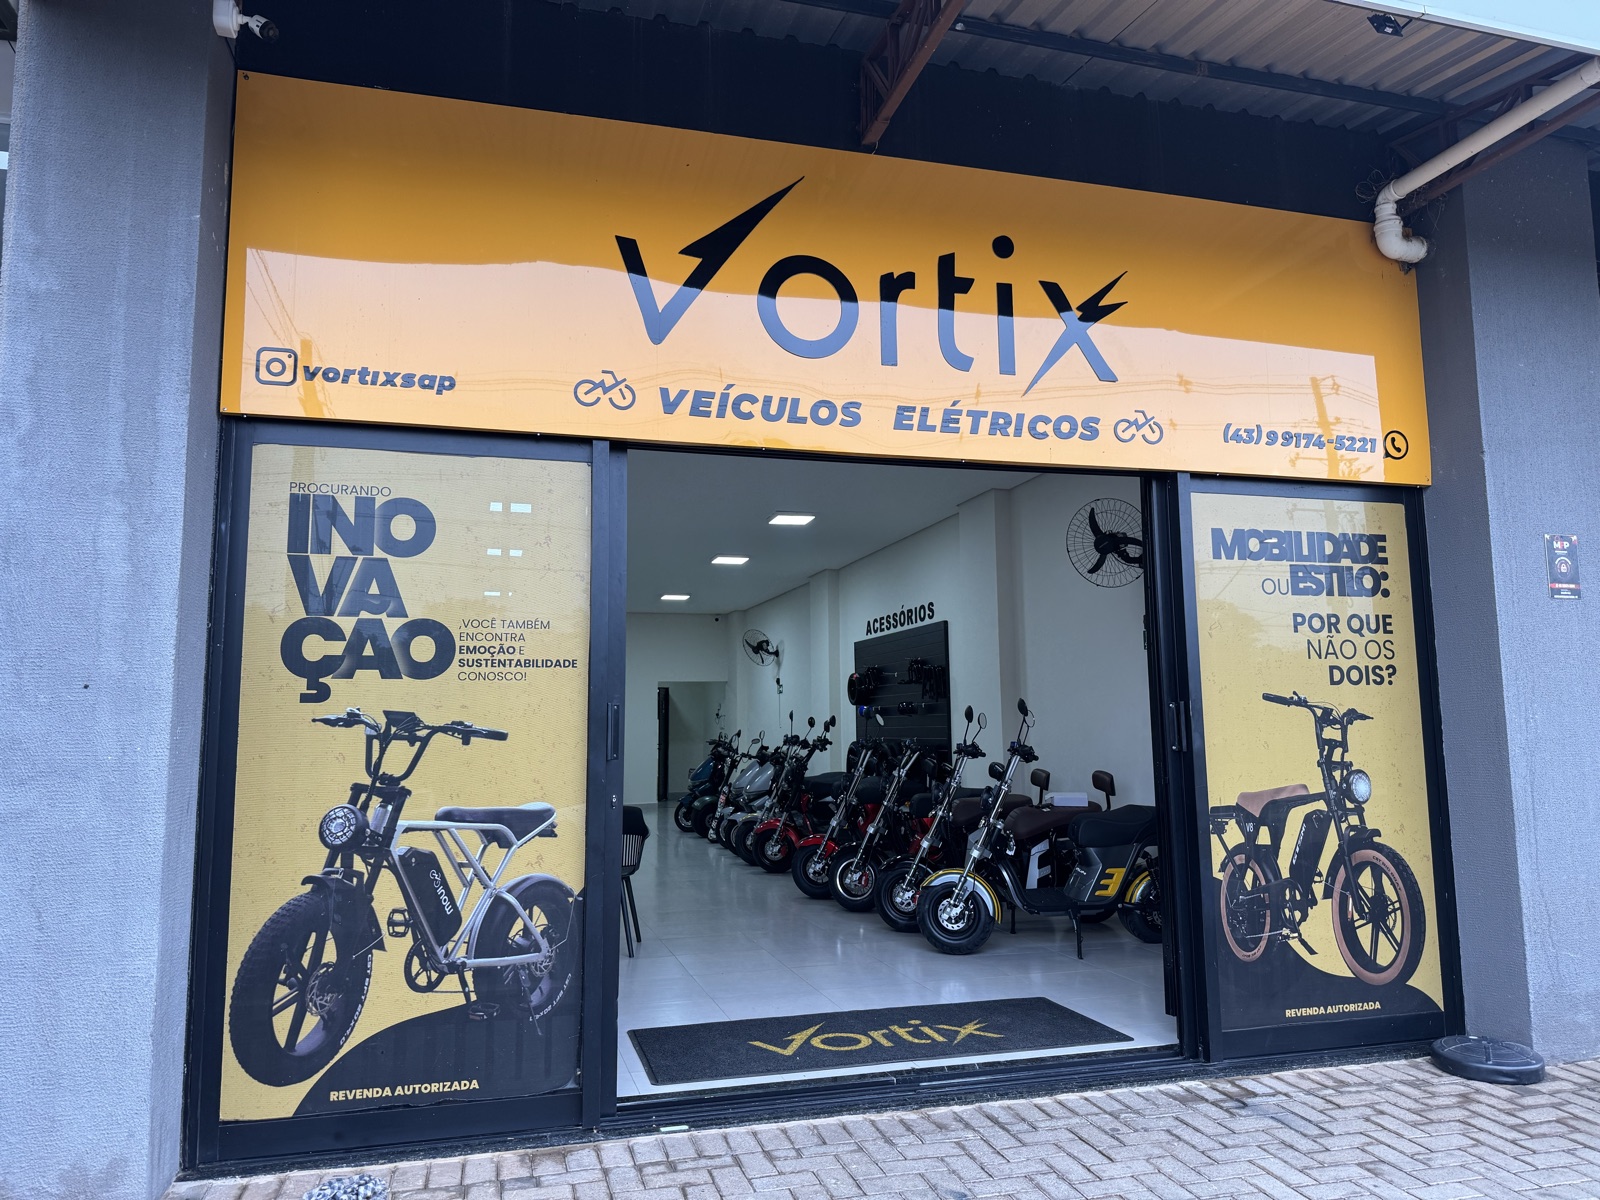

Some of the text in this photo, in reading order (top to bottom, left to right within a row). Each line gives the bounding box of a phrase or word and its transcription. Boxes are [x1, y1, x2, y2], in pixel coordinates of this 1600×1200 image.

[614, 176, 1128, 397] Vortix
[303, 365, 456, 395] vortixsap
[659, 384, 1101, 442] VEÍCULOS ELÉTRICOS
[1223, 423, 1262, 444] (43)
[289, 482, 392, 497] PROCURANDO
[287, 492, 437, 558] INO
[1211, 527, 1389, 565] MOBILIDADE
[287, 554, 409, 618] VA
[1261, 577, 1289, 595] OU
[500, 617, 551, 630] TAMBÉM
[866, 601, 935, 636] ACESSÓRIOS
[1293, 612, 1394, 637] POR QUE
[459, 631, 526, 643] ENCONTRA
[1307, 634, 1395, 660] NÃO OS
[458, 643, 525, 657] EMOÇÃO E
[458, 658, 578, 669] SUSTENTABILIDADE
[1329, 664, 1396, 686] DOIS?
[457, 671, 527, 682] CONOSCO!
[1286, 1001, 1381, 1018] REVENDA AUTORIZADA
[748, 1018, 1004, 1056] Vortix
[329, 1079, 480, 1102] REVENDA AUTORIZADA
